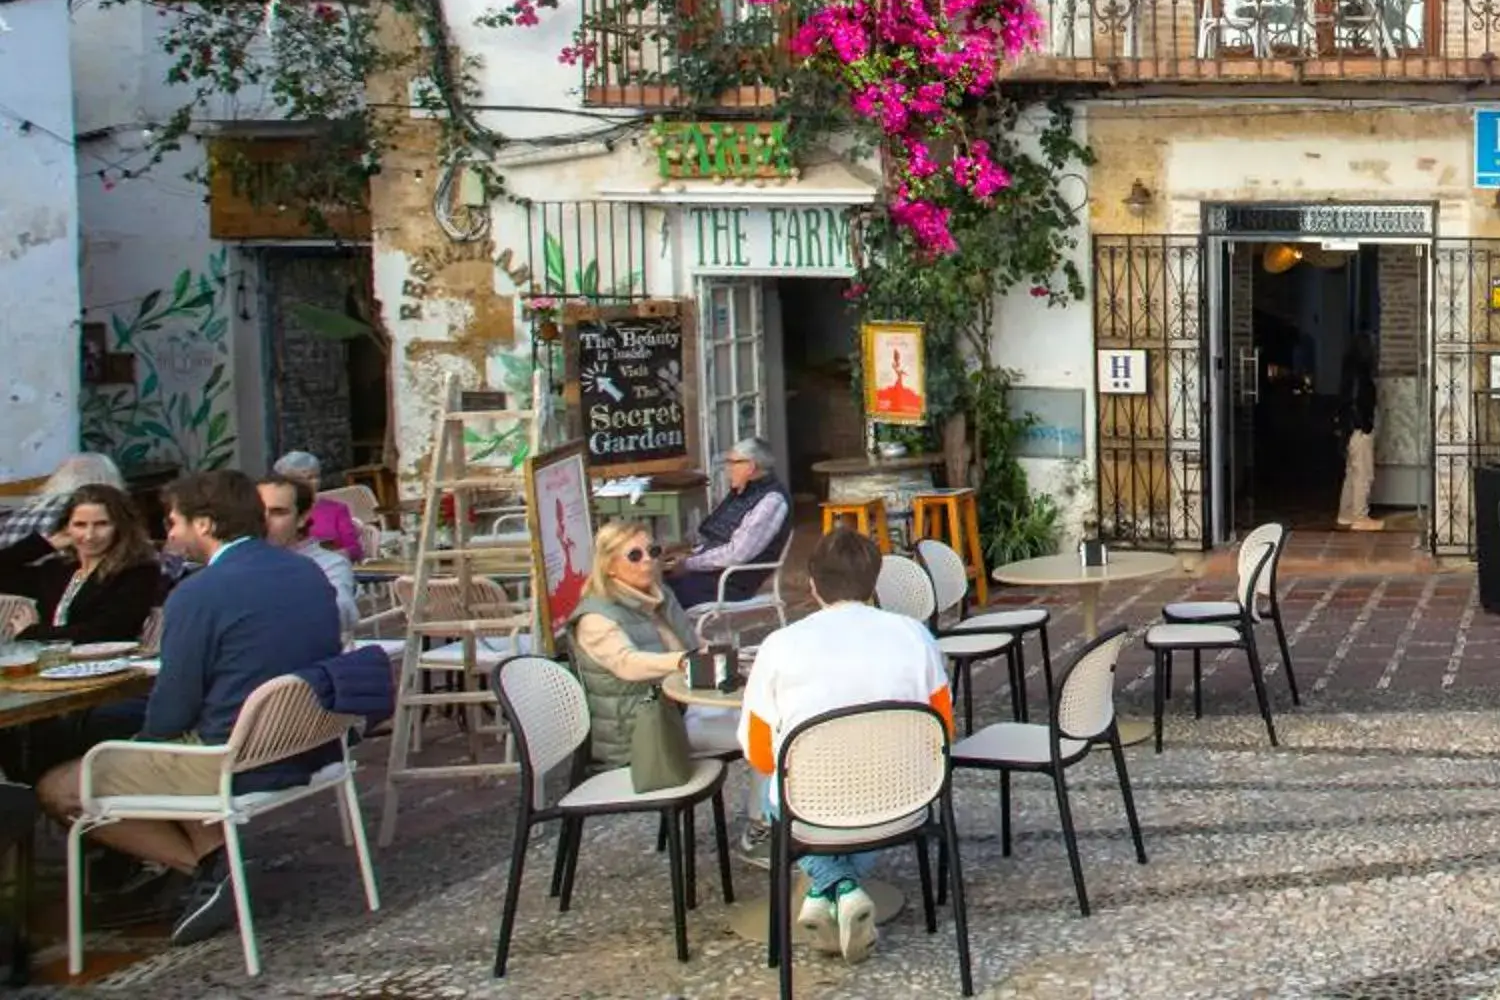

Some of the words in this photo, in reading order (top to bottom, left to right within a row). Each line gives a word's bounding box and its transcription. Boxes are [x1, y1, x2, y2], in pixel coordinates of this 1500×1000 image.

[690, 206, 750, 267] THE
[768, 206, 854, 268] FARM
[579, 332, 616, 349] The
[622, 329, 681, 349] Beauty
[1111, 355, 1132, 379] H
[589, 401, 682, 431] Secret
[588, 425, 683, 455] Garden
